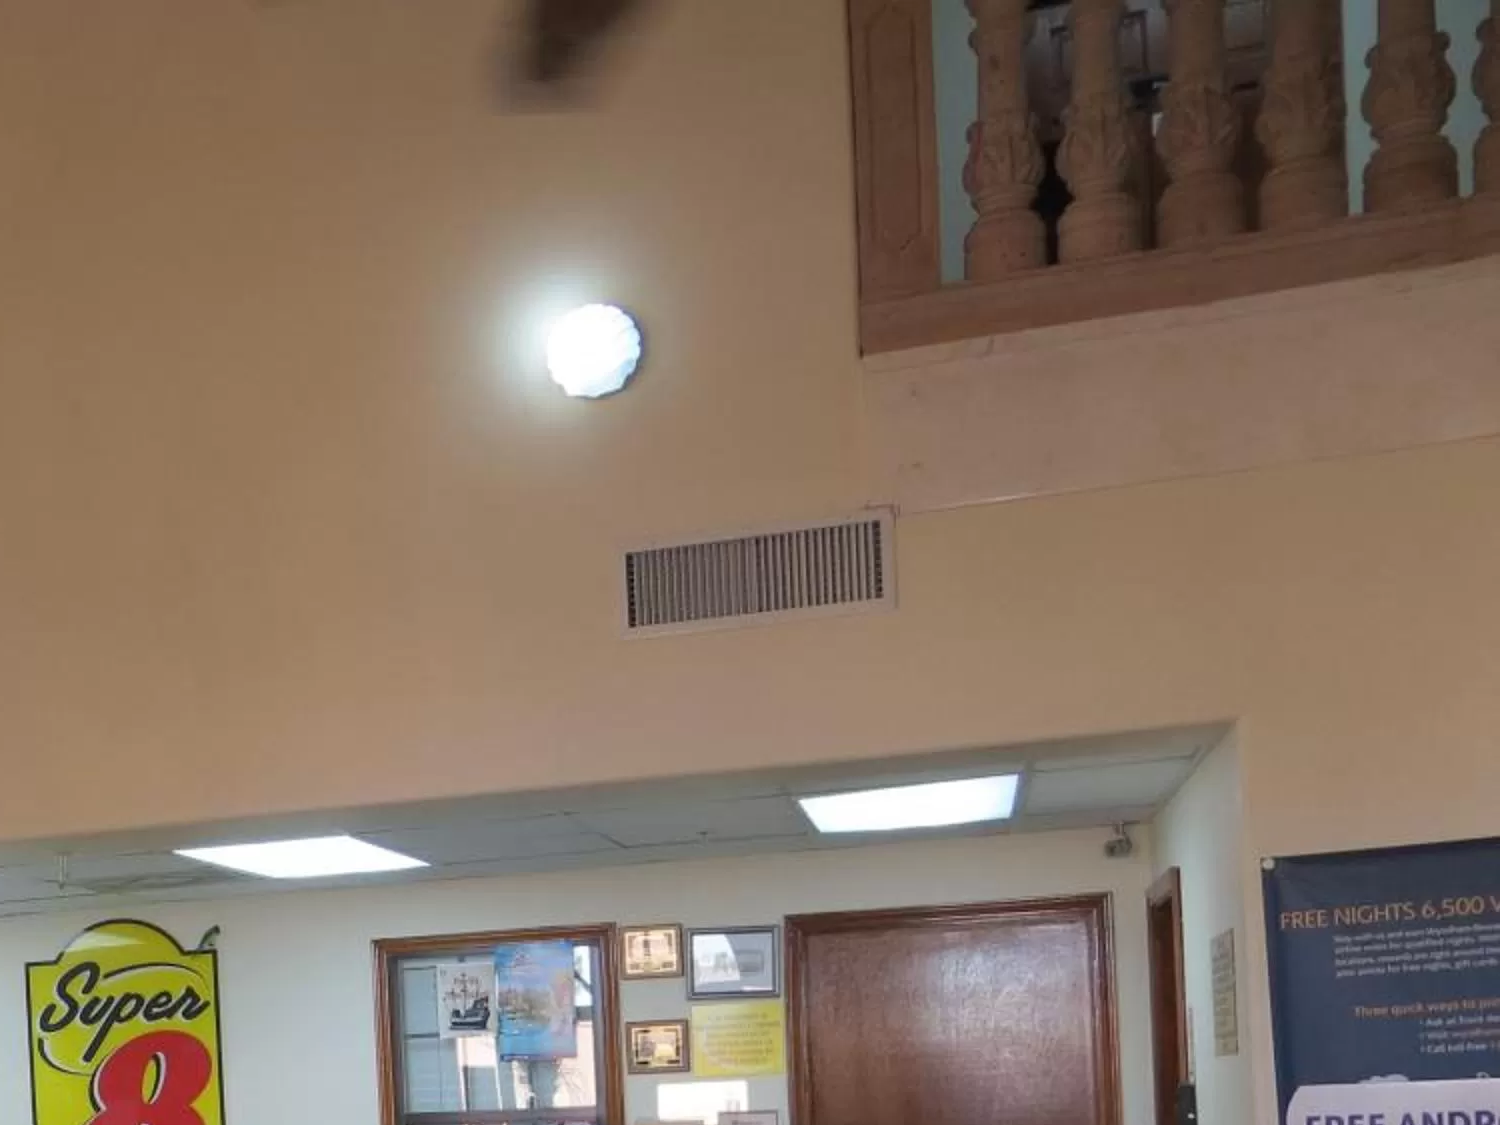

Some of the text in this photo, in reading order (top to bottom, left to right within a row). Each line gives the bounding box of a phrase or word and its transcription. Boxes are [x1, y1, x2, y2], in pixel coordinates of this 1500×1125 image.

[1280, 908, 1329, 929] FREE
[1334, 901, 1415, 925] NIGHTS
[1422, 895, 1485, 920] 6,500
[39, 961, 210, 1064] Super
